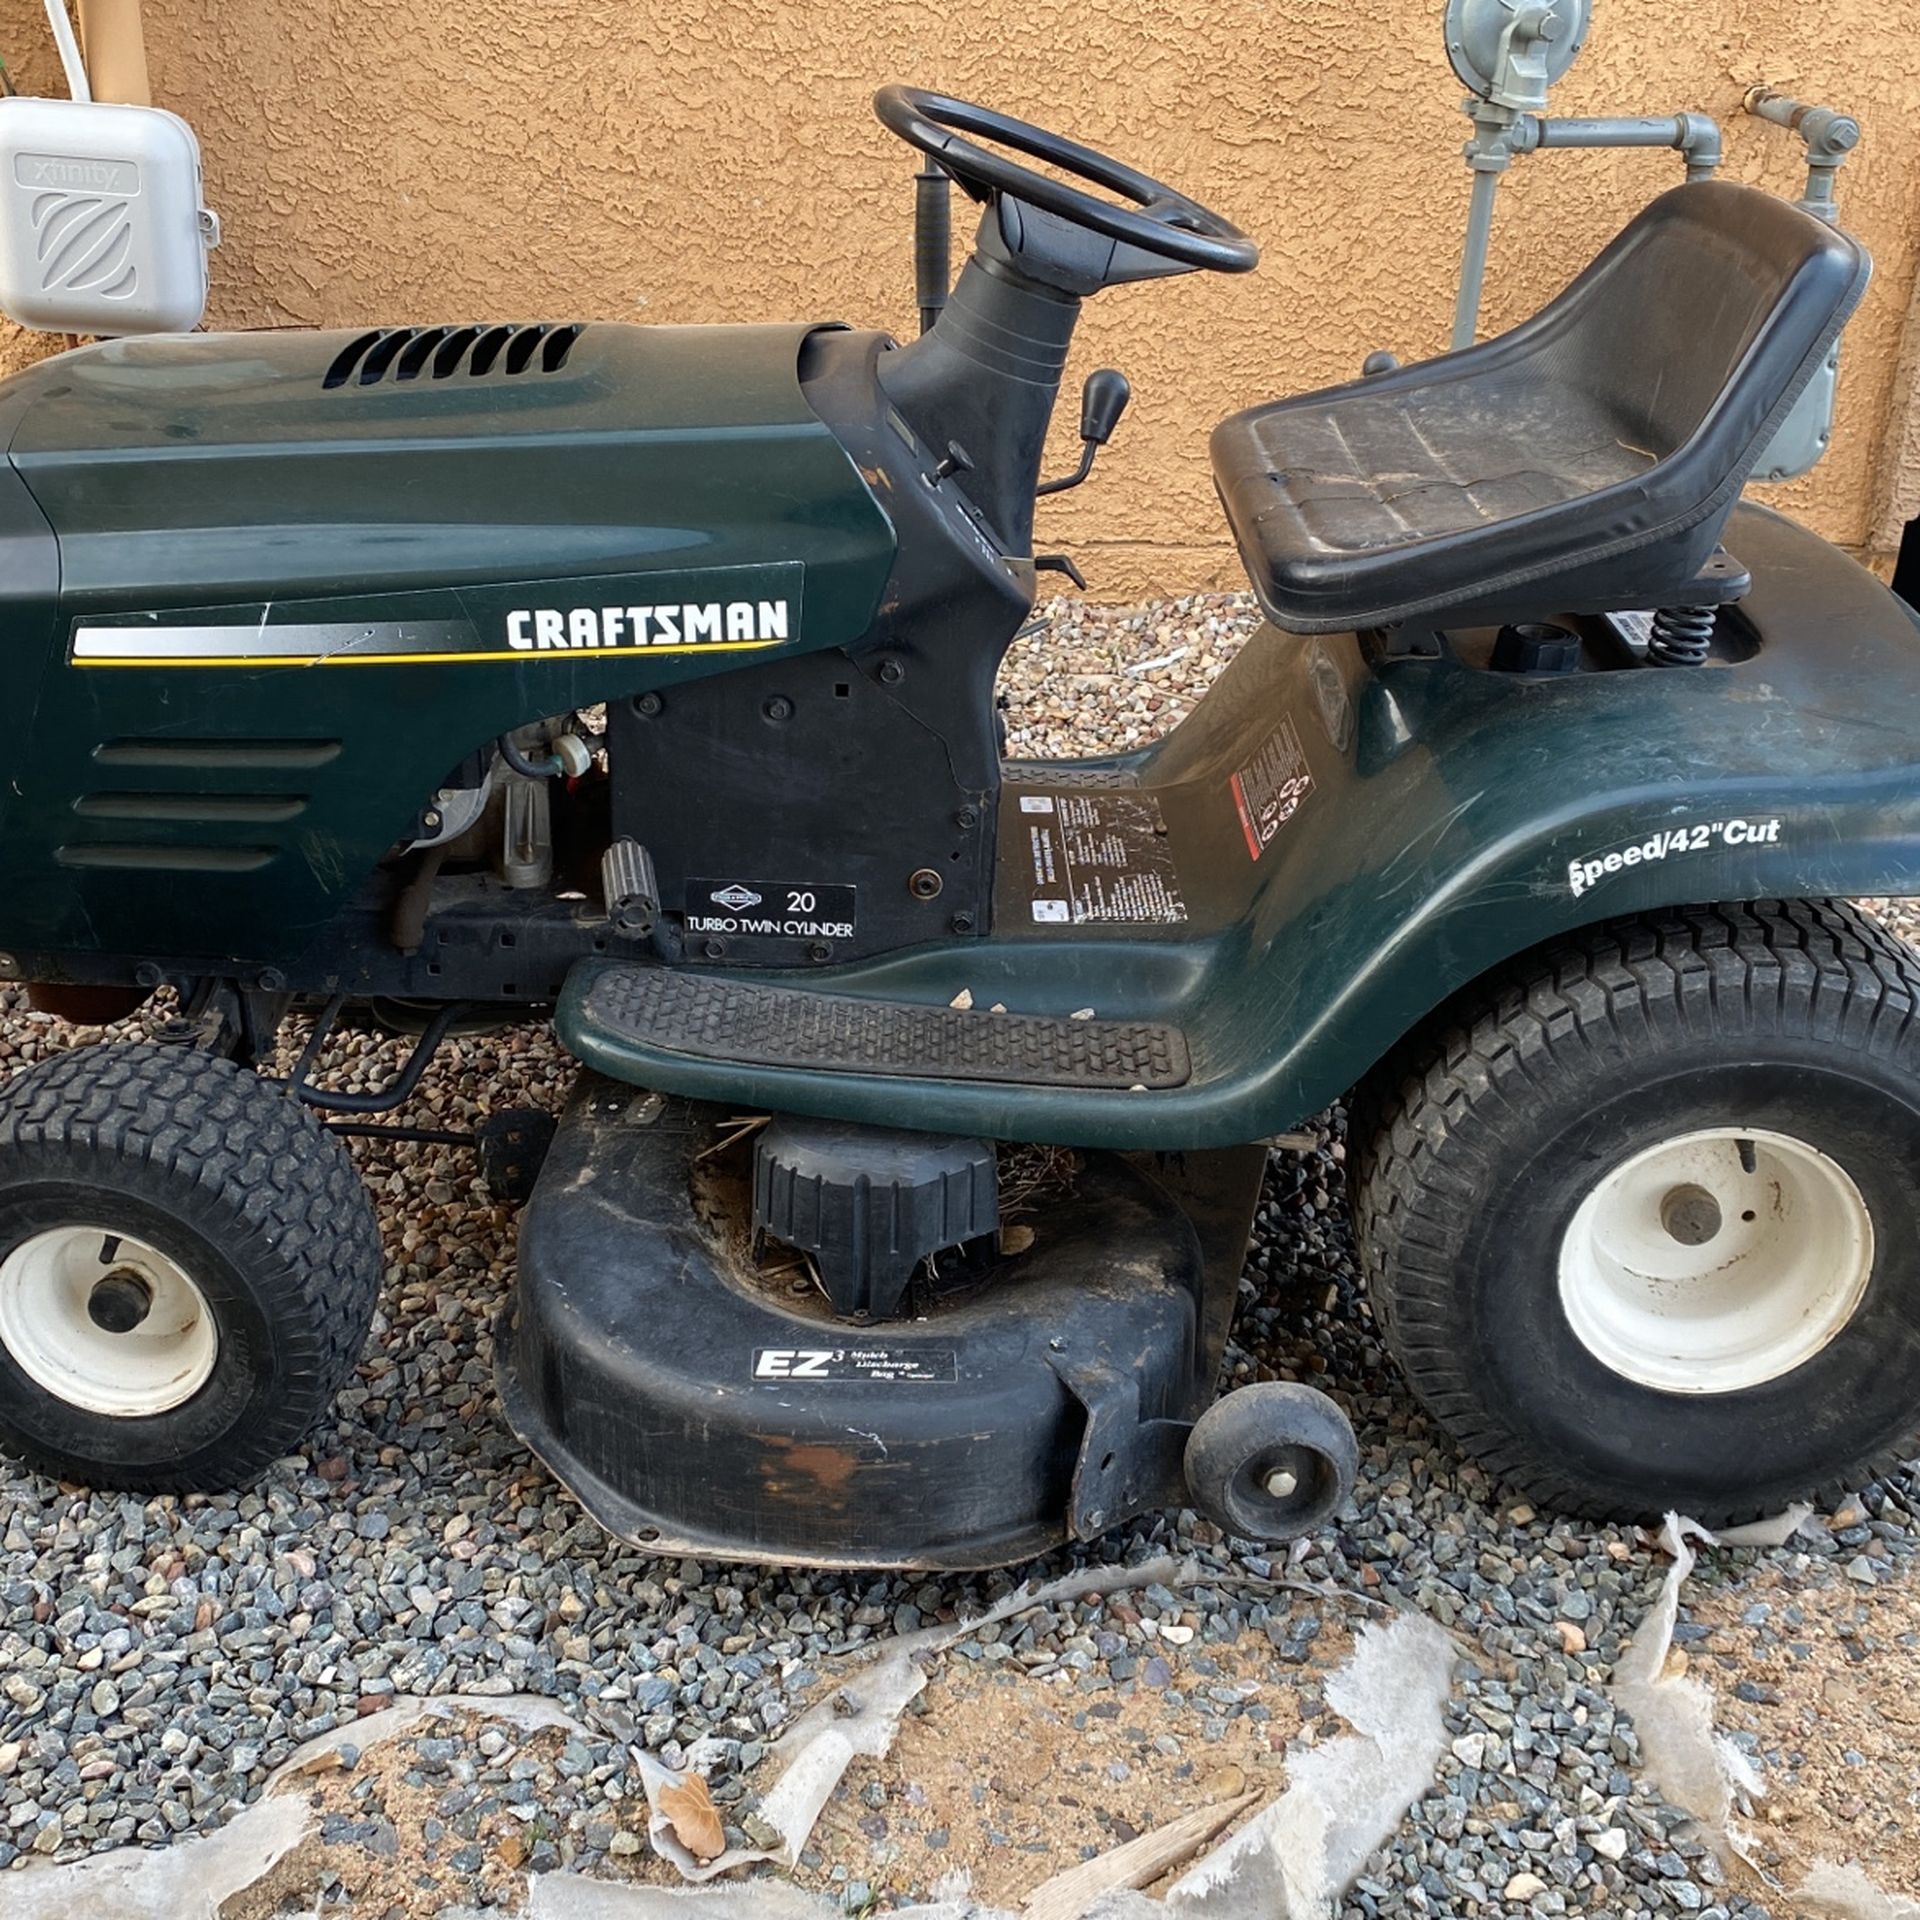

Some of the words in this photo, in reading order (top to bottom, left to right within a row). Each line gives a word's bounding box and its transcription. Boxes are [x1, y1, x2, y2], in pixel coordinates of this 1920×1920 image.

[33, 160, 119, 191] xfinity
[506, 600, 788, 650] CRAFTSMAN
[787, 891, 816, 912] 20
[687, 916, 738, 932] TURBO
[740, 918, 781, 934] TWIN
[783, 920, 854, 938] CYLINDER
